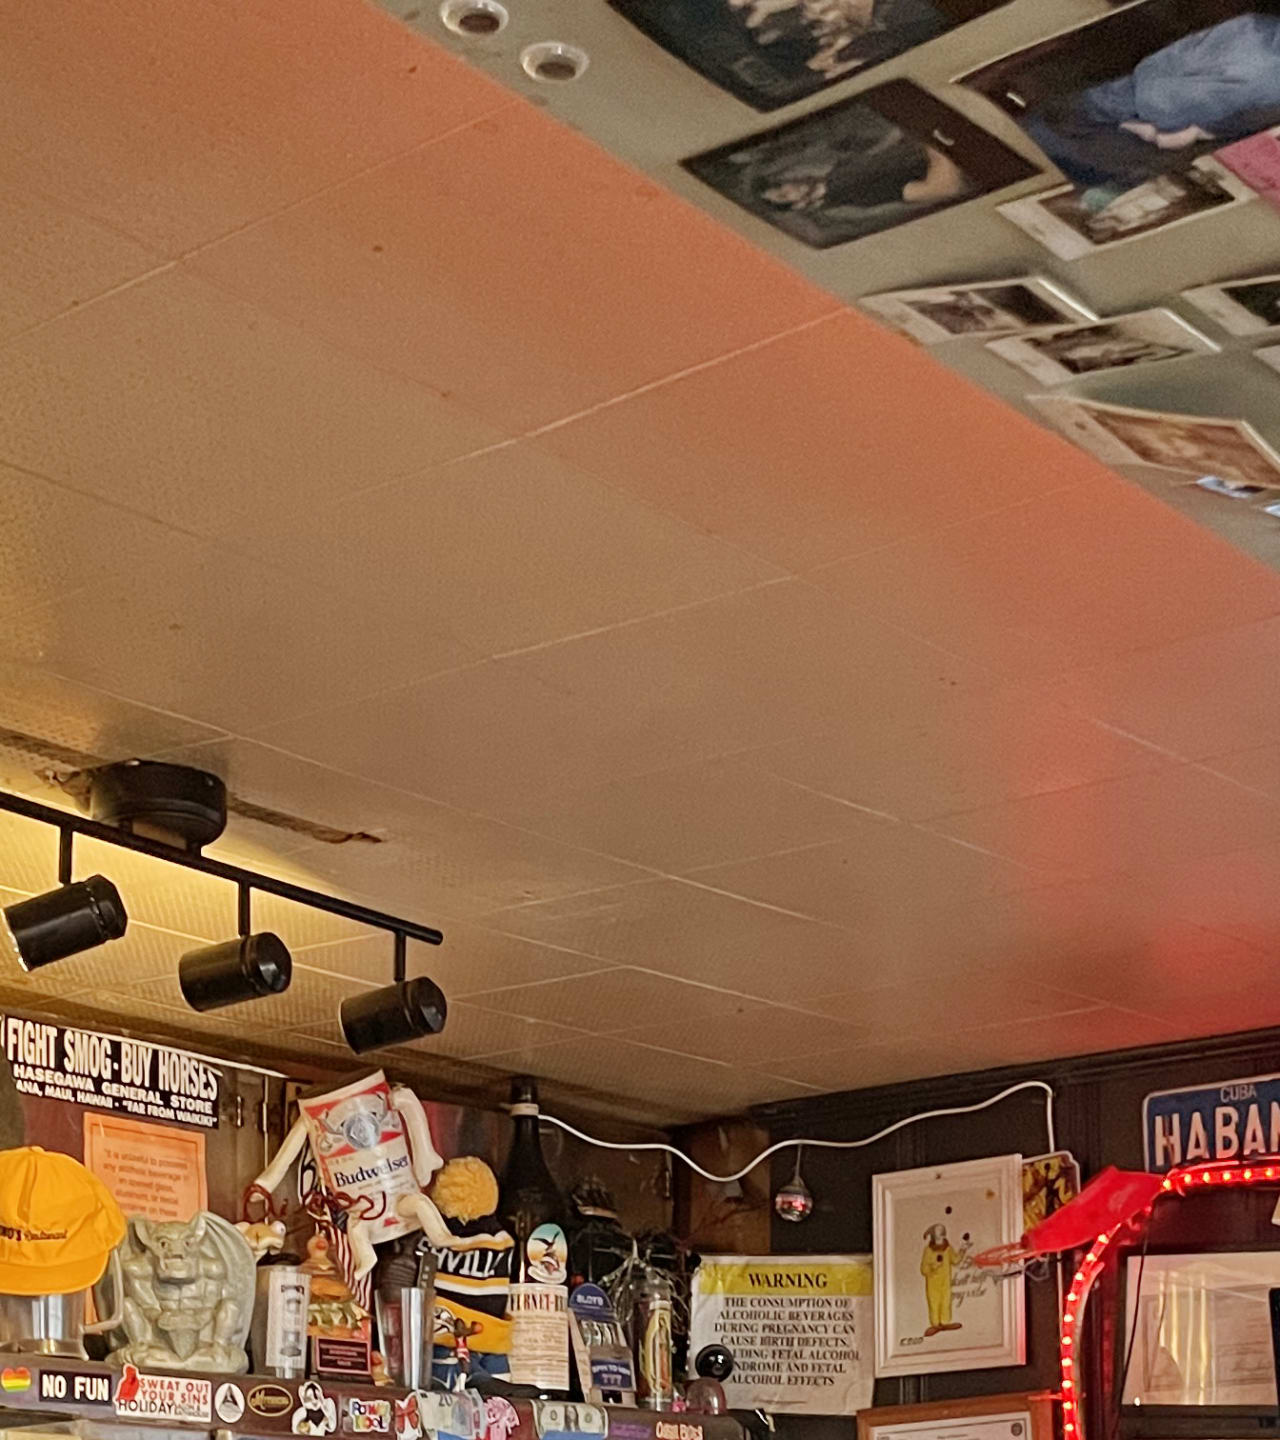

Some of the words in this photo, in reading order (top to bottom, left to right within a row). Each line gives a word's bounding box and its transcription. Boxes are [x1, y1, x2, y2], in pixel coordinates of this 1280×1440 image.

[8, 1018, 57, 1067] FIGHT
[158, 1051, 218, 1100] HORSES
[13, 1064, 94, 1091] HASEGAWA
[102, 1082, 163, 1105] GENERAL
[170, 1095, 213, 1114] STORE
[1221, 1085, 1257, 1102] CUBA
[148, 1105, 175, 1120] FROM
[748, 1273, 828, 1288] WARNING
[724, 1297, 746, 1307] THE
[750, 1298, 832, 1308] CONSUMPTION
[835, 1298, 850, 1308] OF
[720, 1311, 784, 1321] ALCOHOLIC
[788, 1311, 854, 1321] BEVERAGES
[714, 1323, 758, 1333] DURING
[762, 1324, 829, 1334] PREGNANCY
[832, 1324, 856, 1334] CAN
[721, 1336, 756, 1346] CAUSE
[760, 1337, 794, 1346] BIRTH
[733, 1349, 768, 1359] UDING
[772, 1350, 805, 1360] FETAL
[808, 1350, 860, 1361] ALCOHOL
[734, 1361, 783, 1372] NDROME
[785, 1362, 808, 1372] AND
[811, 1362, 846, 1373] FETAL
[42, 1374, 67, 1397] NO
[74, 1377, 109, 1401] FUN
[139, 1379, 180, 1391] SWEAT
[186, 1383, 209, 1393] OUT
[729, 1375, 784, 1385] ALCOHOL
[787, 1376, 835, 1386] EFFECTS
[142, 1390, 175, 1401] YOUR
[181, 1393, 208, 1405] SINS
[119, 1399, 174, 1414] HOLIDAY
